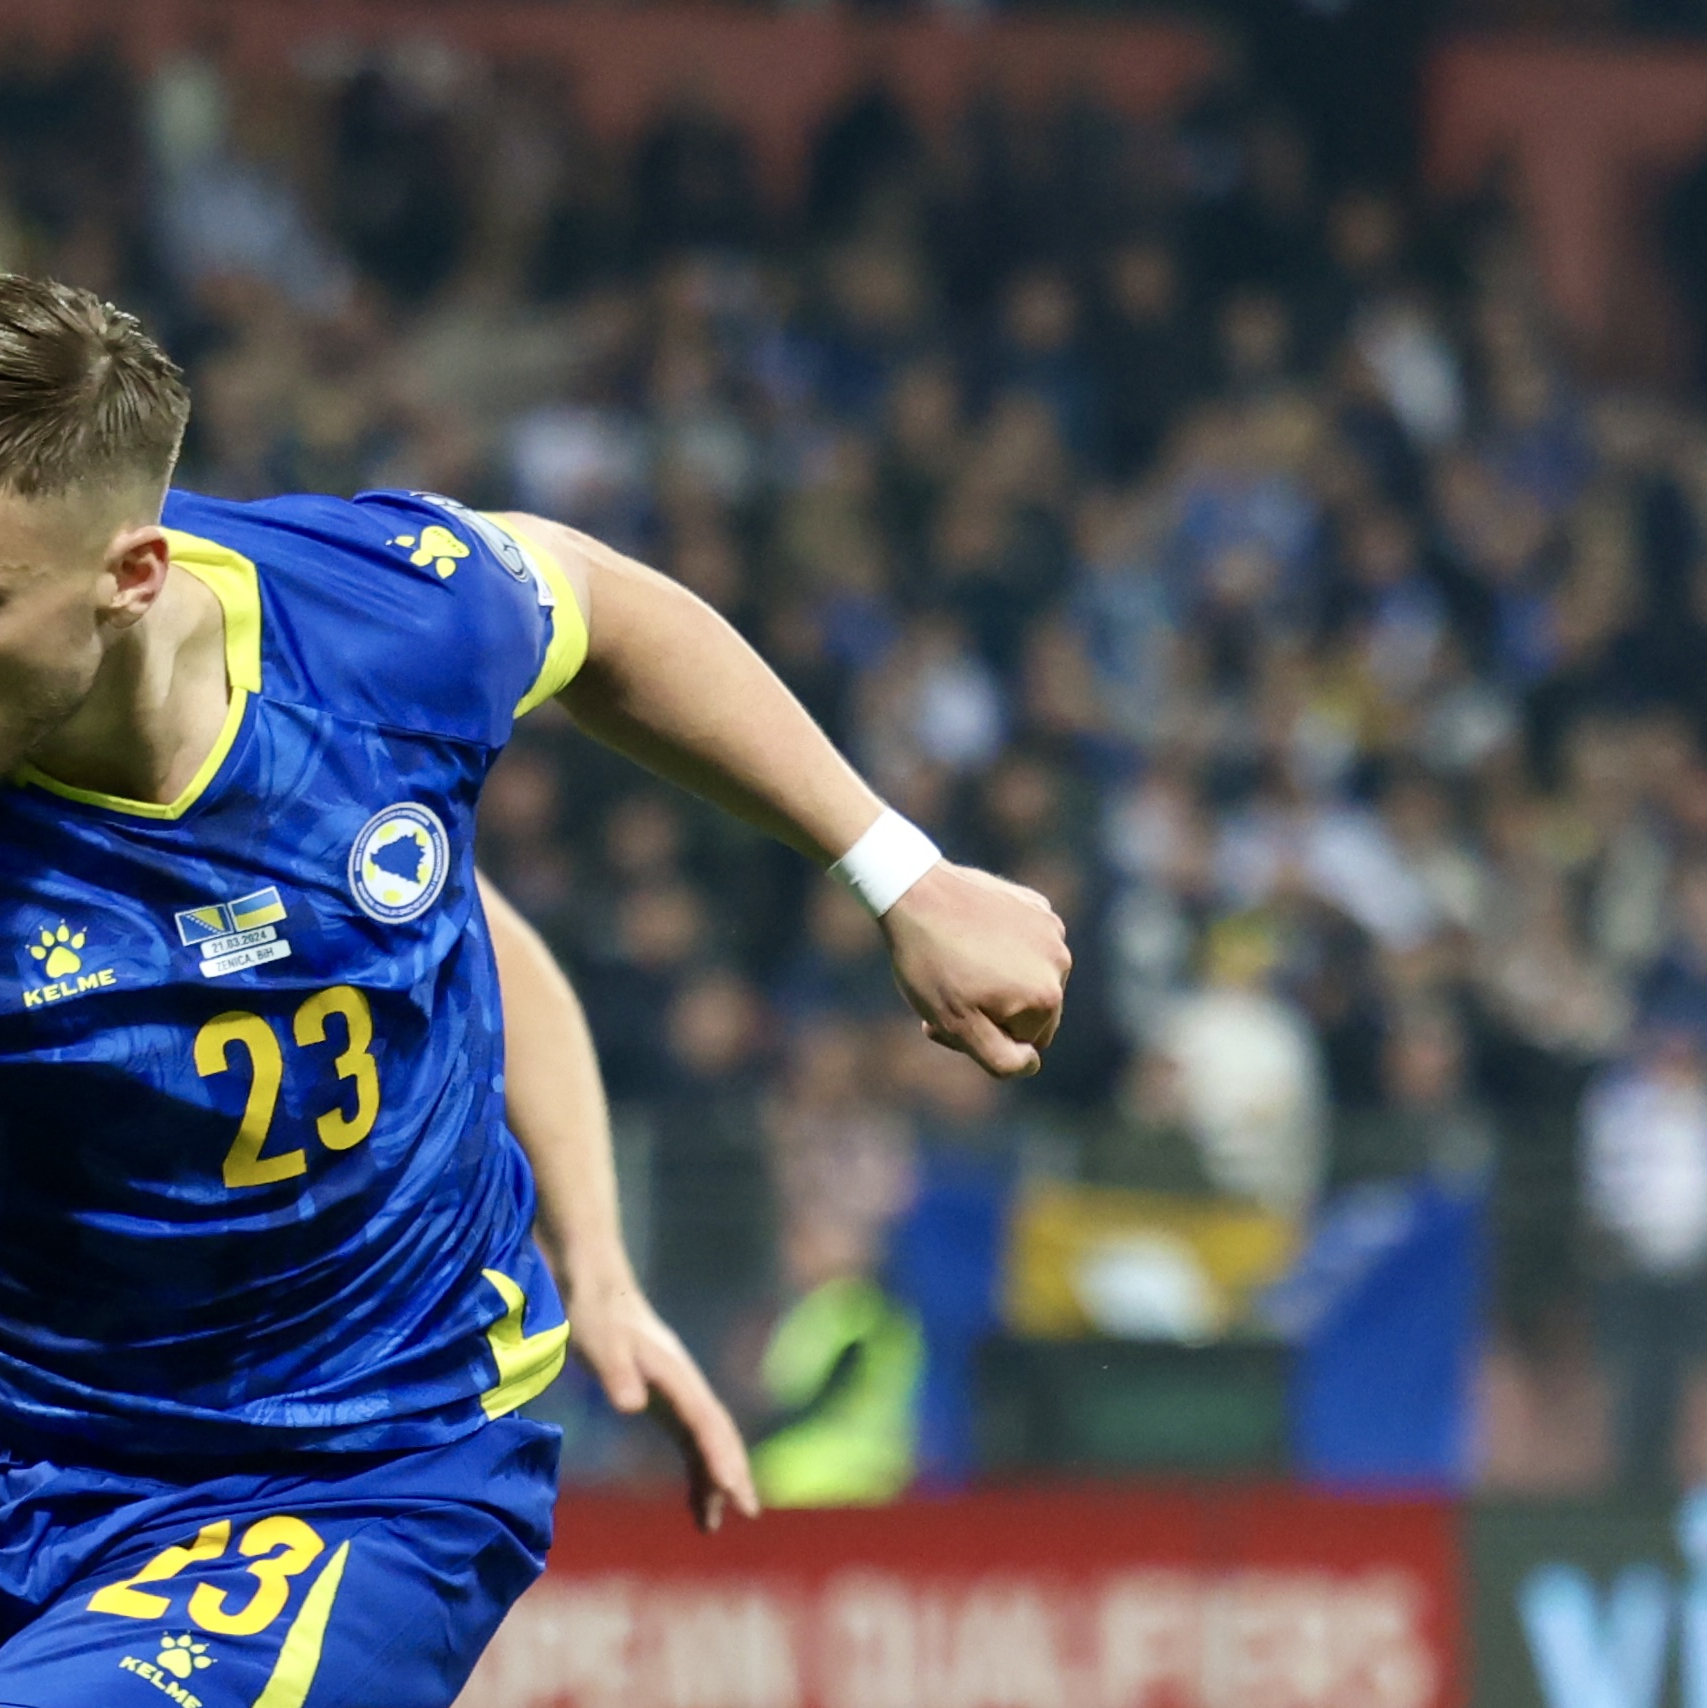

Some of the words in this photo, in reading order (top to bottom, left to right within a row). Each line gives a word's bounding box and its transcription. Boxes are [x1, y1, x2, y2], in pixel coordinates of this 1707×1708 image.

[211, 930, 268, 954] 21.03.2024
[23, 968, 117, 1008] KELME
[194, 985, 381, 1188] 23
[85, 1515, 325, 1636] 23
